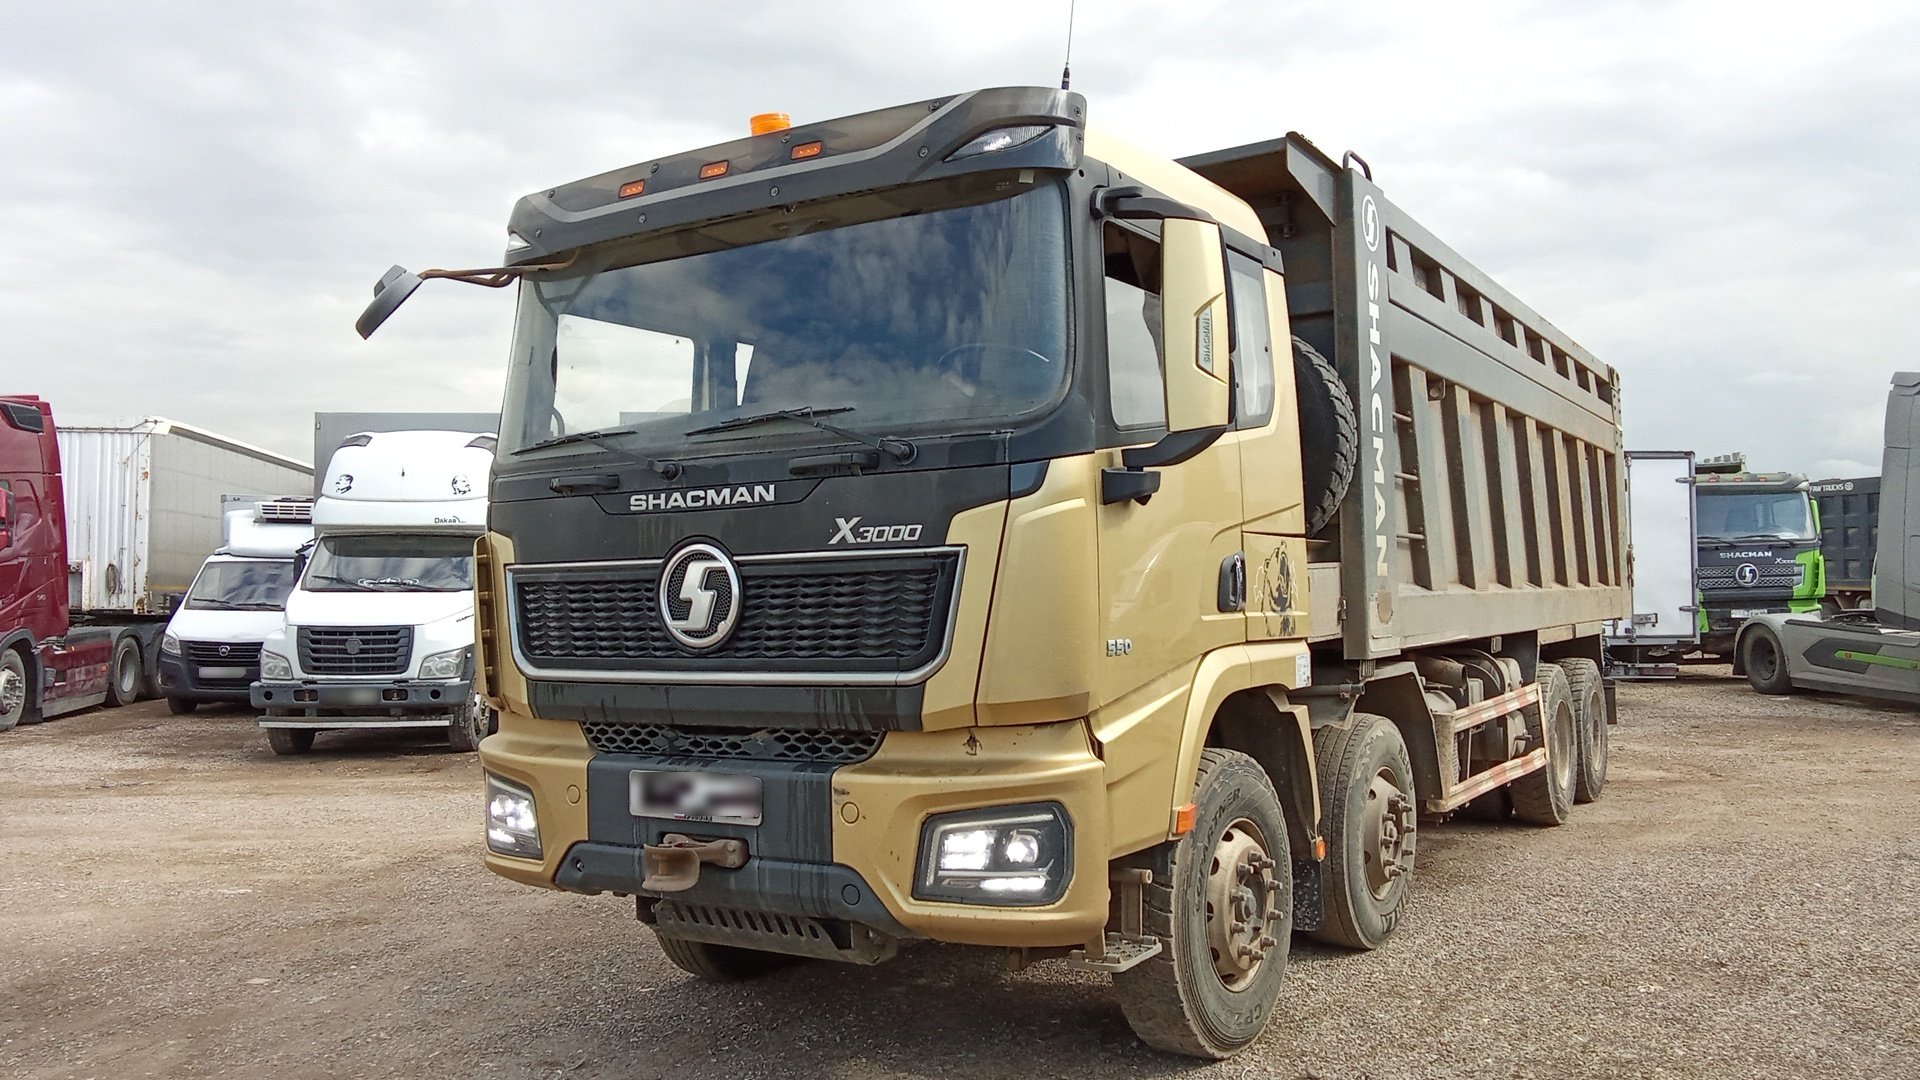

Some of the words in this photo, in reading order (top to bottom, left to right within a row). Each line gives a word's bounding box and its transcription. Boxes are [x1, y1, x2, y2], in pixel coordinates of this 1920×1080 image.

[1202, 317, 1211, 363] SHACMAN
[1366, 258, 1389, 577] SHACMAN
[629, 484, 775, 511] SHACMAN
[828, 516, 923, 545] X3000
[1720, 551, 1772, 559] SHACMAN
[1106, 639, 1133, 657] 550
